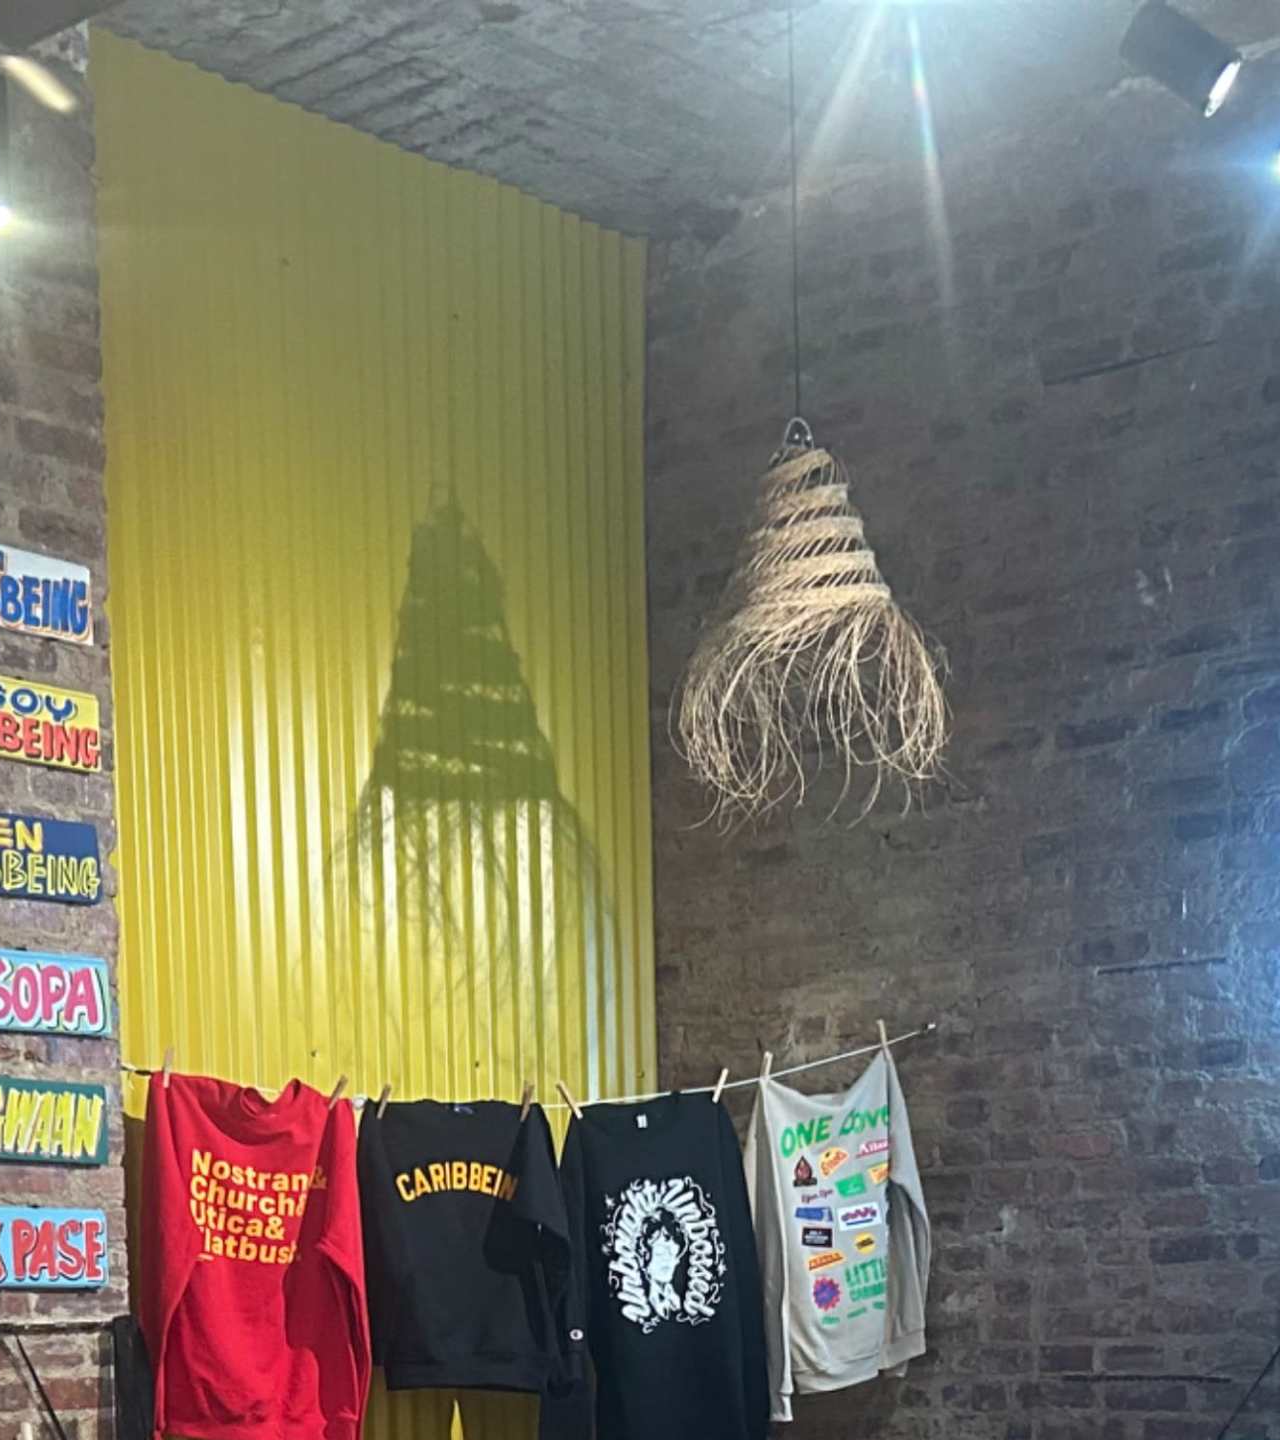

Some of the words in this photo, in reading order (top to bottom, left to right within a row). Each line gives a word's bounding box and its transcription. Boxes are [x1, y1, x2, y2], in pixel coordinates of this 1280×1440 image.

[780, 1115, 833, 1158] ONE
[190, 1199, 284, 1240] Utica&
[10, 1217, 107, 1284] PASE
